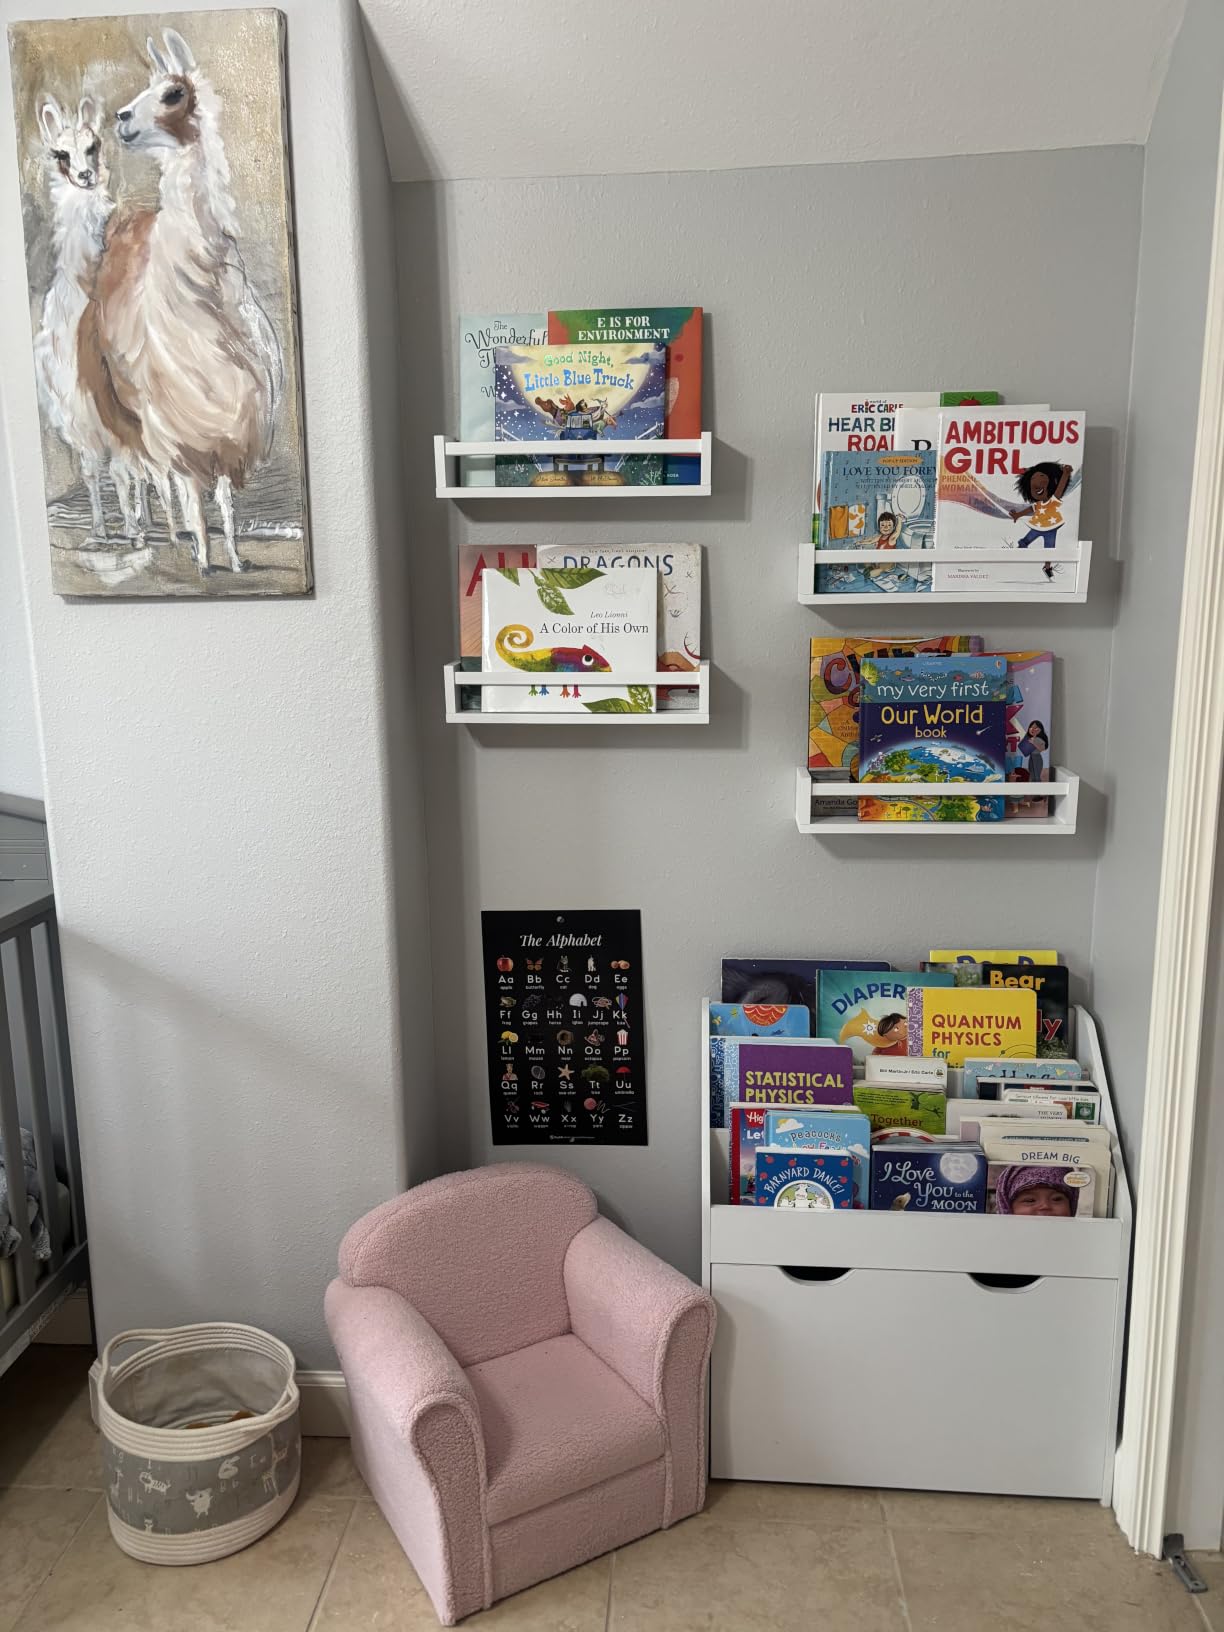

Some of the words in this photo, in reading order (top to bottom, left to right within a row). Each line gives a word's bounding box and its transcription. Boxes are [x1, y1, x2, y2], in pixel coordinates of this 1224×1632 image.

[494, 321, 508, 330] The
[597, 318, 606, 328] E
[608, 317, 622, 328] IS
[625, 316, 651, 327] FOR
[578, 328, 670, 341] ENVIRONMENT
[543, 354, 573, 368] Good
[578, 351, 614, 367] Night,
[524, 371, 559, 392] Little
[562, 369, 592, 387] Blue
[592, 368, 634, 390] Truck
[851, 402, 876, 413] ERIC
[828, 417, 875, 432] HEAR
[880, 417, 895, 432] B
[944, 420, 1079, 445] AMBITIOUS
[944, 447, 1026, 475] GIRL
[843, 467, 872, 476] LOVE
[873, 467, 900, 476] YOU
[563, 554, 674, 576] DRAGONS
[540, 623, 550, 634] A
[552, 622, 583, 634] Color
[586, 622, 599, 634] of
[601, 622, 620, 634] His
[623, 623, 649, 634] Own
[877, 685, 906, 700] my
[907, 685, 948, 700] very
[951, 682, 989, 697] first
[881, 705, 918, 725] Our
[924, 703, 983, 725] World
[915, 726, 947, 739] book
[519, 934, 542, 947] The
[546, 933, 602, 949] Alphabet
[990, 970, 1045, 990] Bear
[831, 983, 906, 1015] DIAPER
[931, 1014, 1021, 1030] QUANTUM
[931, 1031, 1002, 1046] PHYSICS
[932, 1048, 950, 1059] for
[745, 1071, 845, 1088] STATISTICAL
[745, 1088, 815, 1104] PHYSICS
[871, 1114, 924, 1128] Together
[1021, 1152, 1058, 1161] DREAM
[1062, 1153, 1081, 1164] BIG
[764, 1166, 809, 1194] BARNYARD
[812, 1167, 845, 1195] DANCE!
[878, 1161, 891, 1182] I
[892, 1162, 937, 1184] Love
[963, 1190, 974, 1198] the
[931, 1199, 977, 1211] MOON
